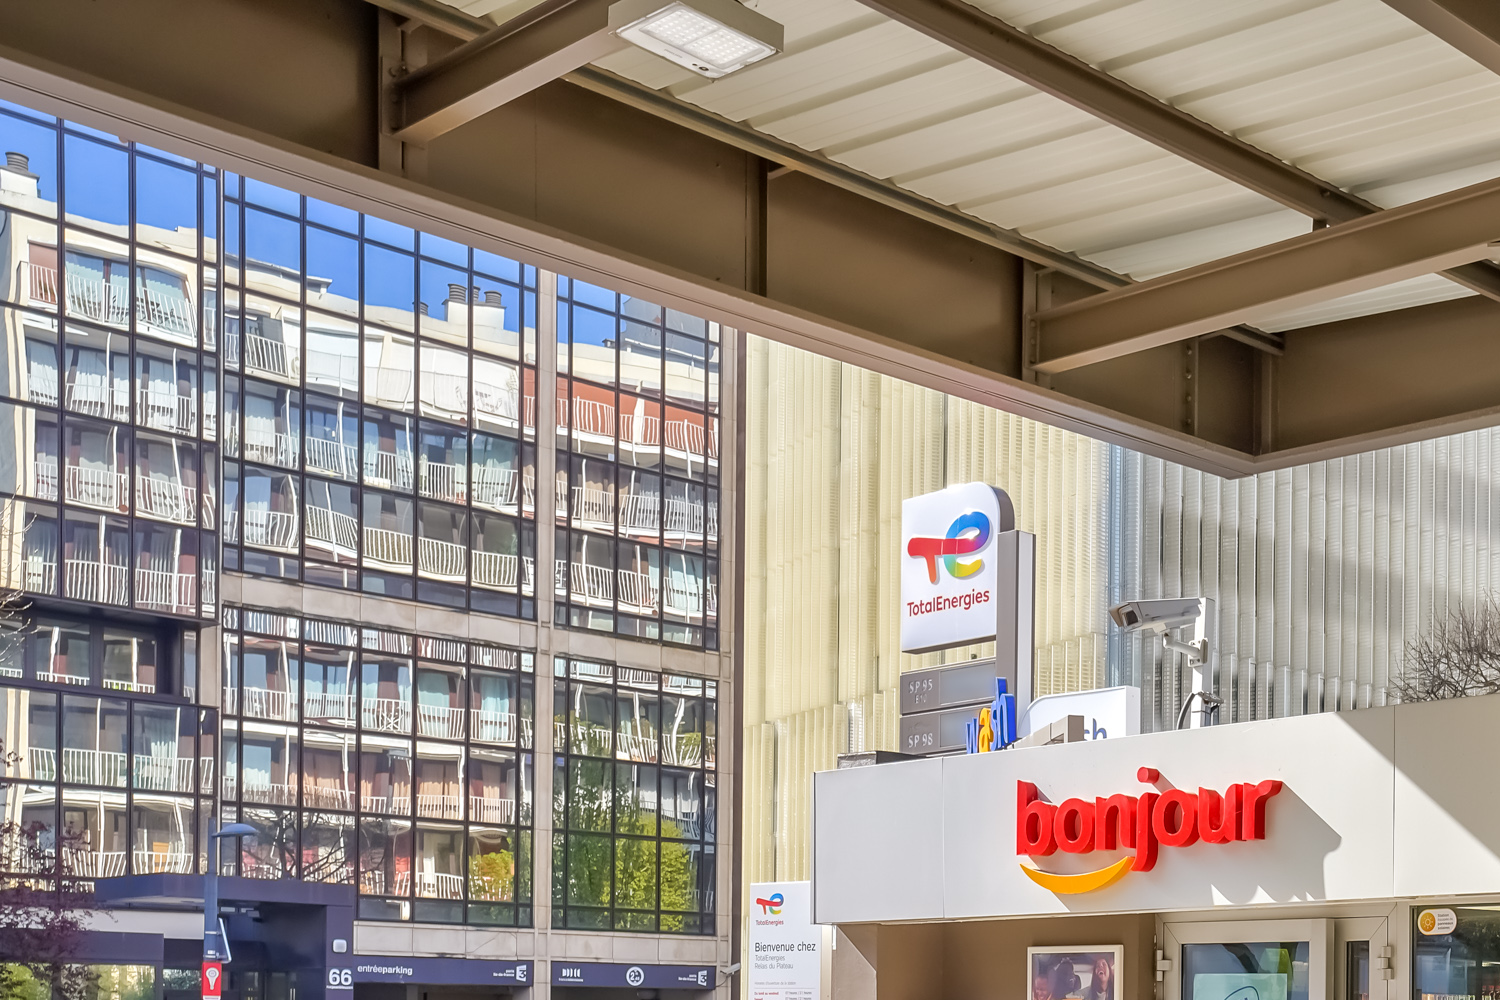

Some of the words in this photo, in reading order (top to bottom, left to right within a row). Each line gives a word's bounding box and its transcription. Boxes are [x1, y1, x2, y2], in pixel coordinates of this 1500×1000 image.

[907, 588, 990, 617] TotalEnergies
[909, 681, 920, 694] SP
[922, 679, 933, 691] 95
[966, 677, 1015, 754] wash
[908, 735, 920, 748] SP
[922, 733, 933, 746] 98
[1016, 766, 1283, 872] bonjour
[755, 942, 794, 952] Bienvenue
[797, 941, 816, 951] chez
[329, 968, 352, 986] 66
